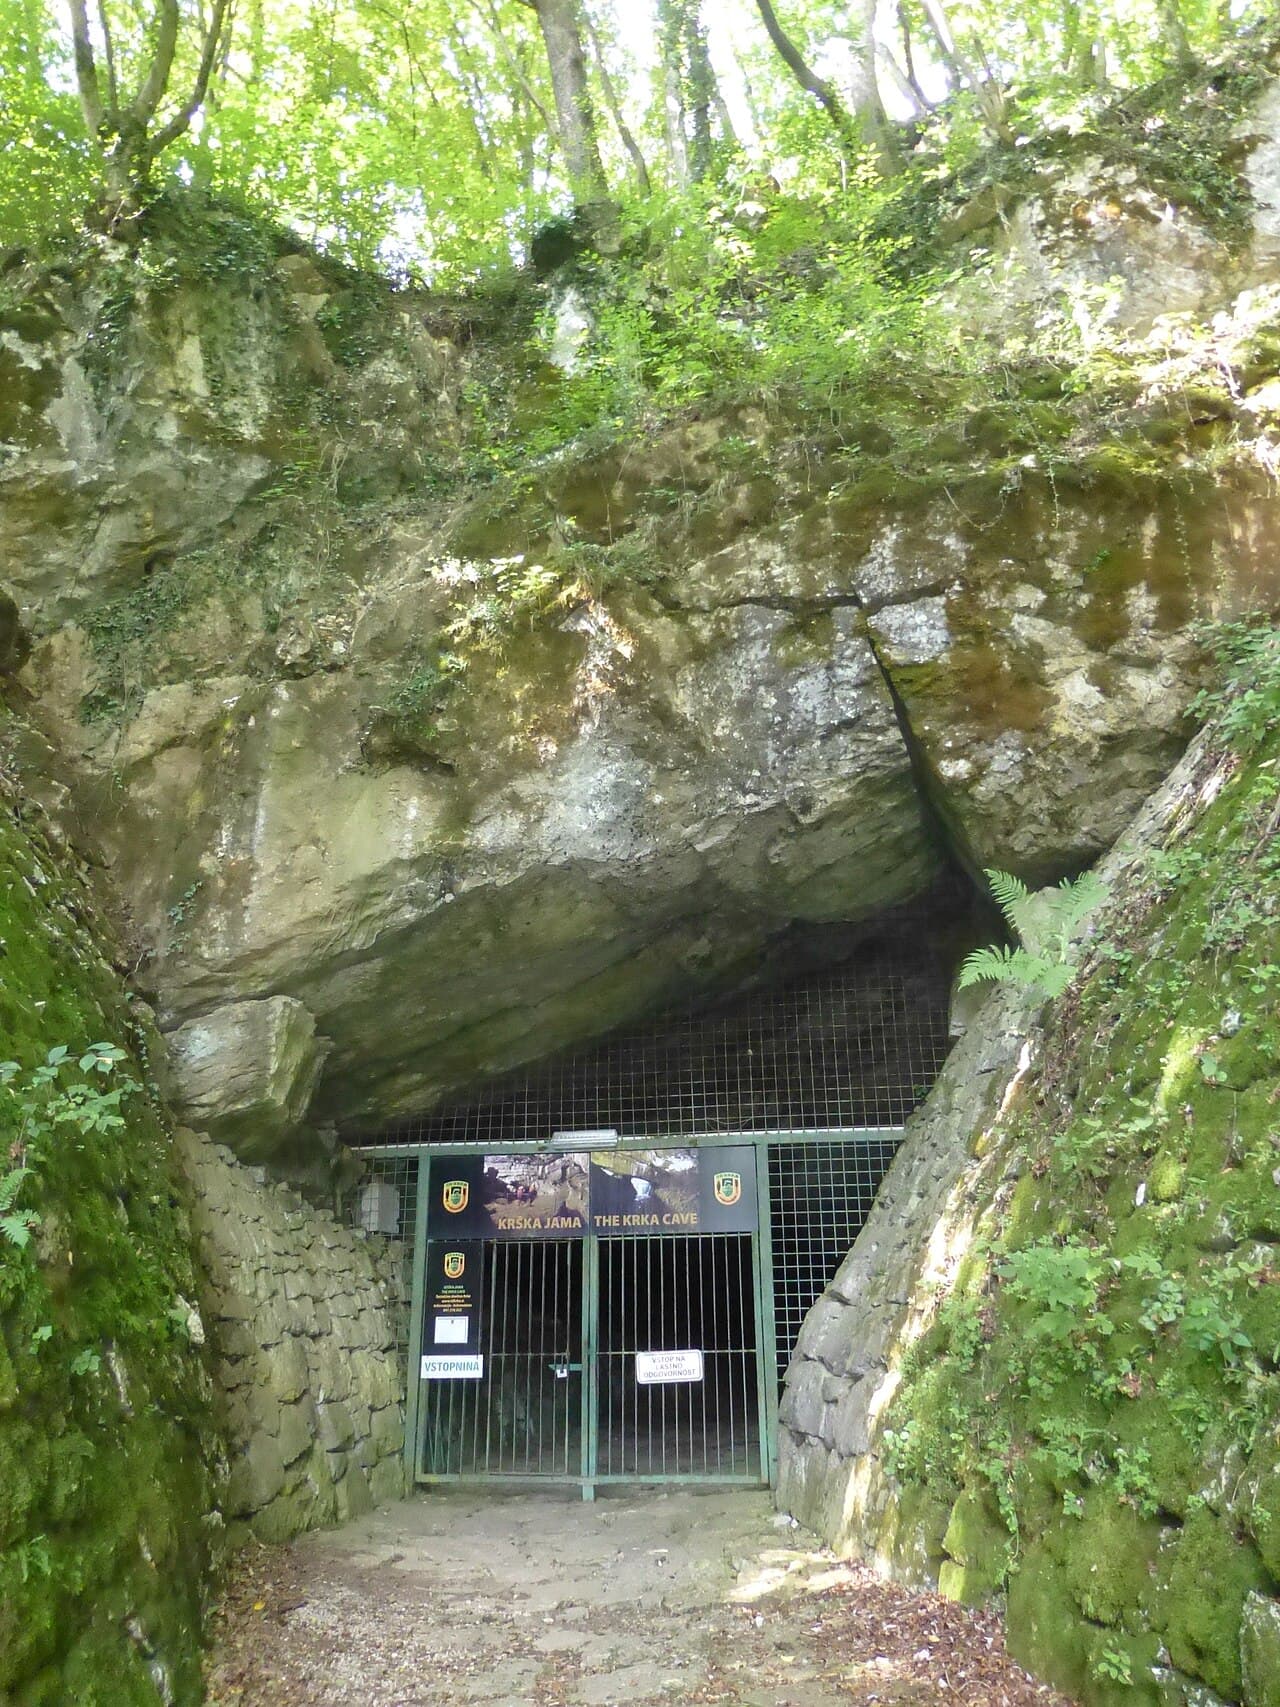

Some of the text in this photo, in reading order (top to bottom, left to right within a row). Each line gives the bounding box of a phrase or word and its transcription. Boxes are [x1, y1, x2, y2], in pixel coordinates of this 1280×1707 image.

[498, 1215, 582, 1230] KRŠKA JAMA
[594, 1212, 698, 1227] THE KRKA CAVE
[424, 1361, 480, 1372] VSTOPNINA
[643, 1369, 696, 1378] ODGOVORNOST
